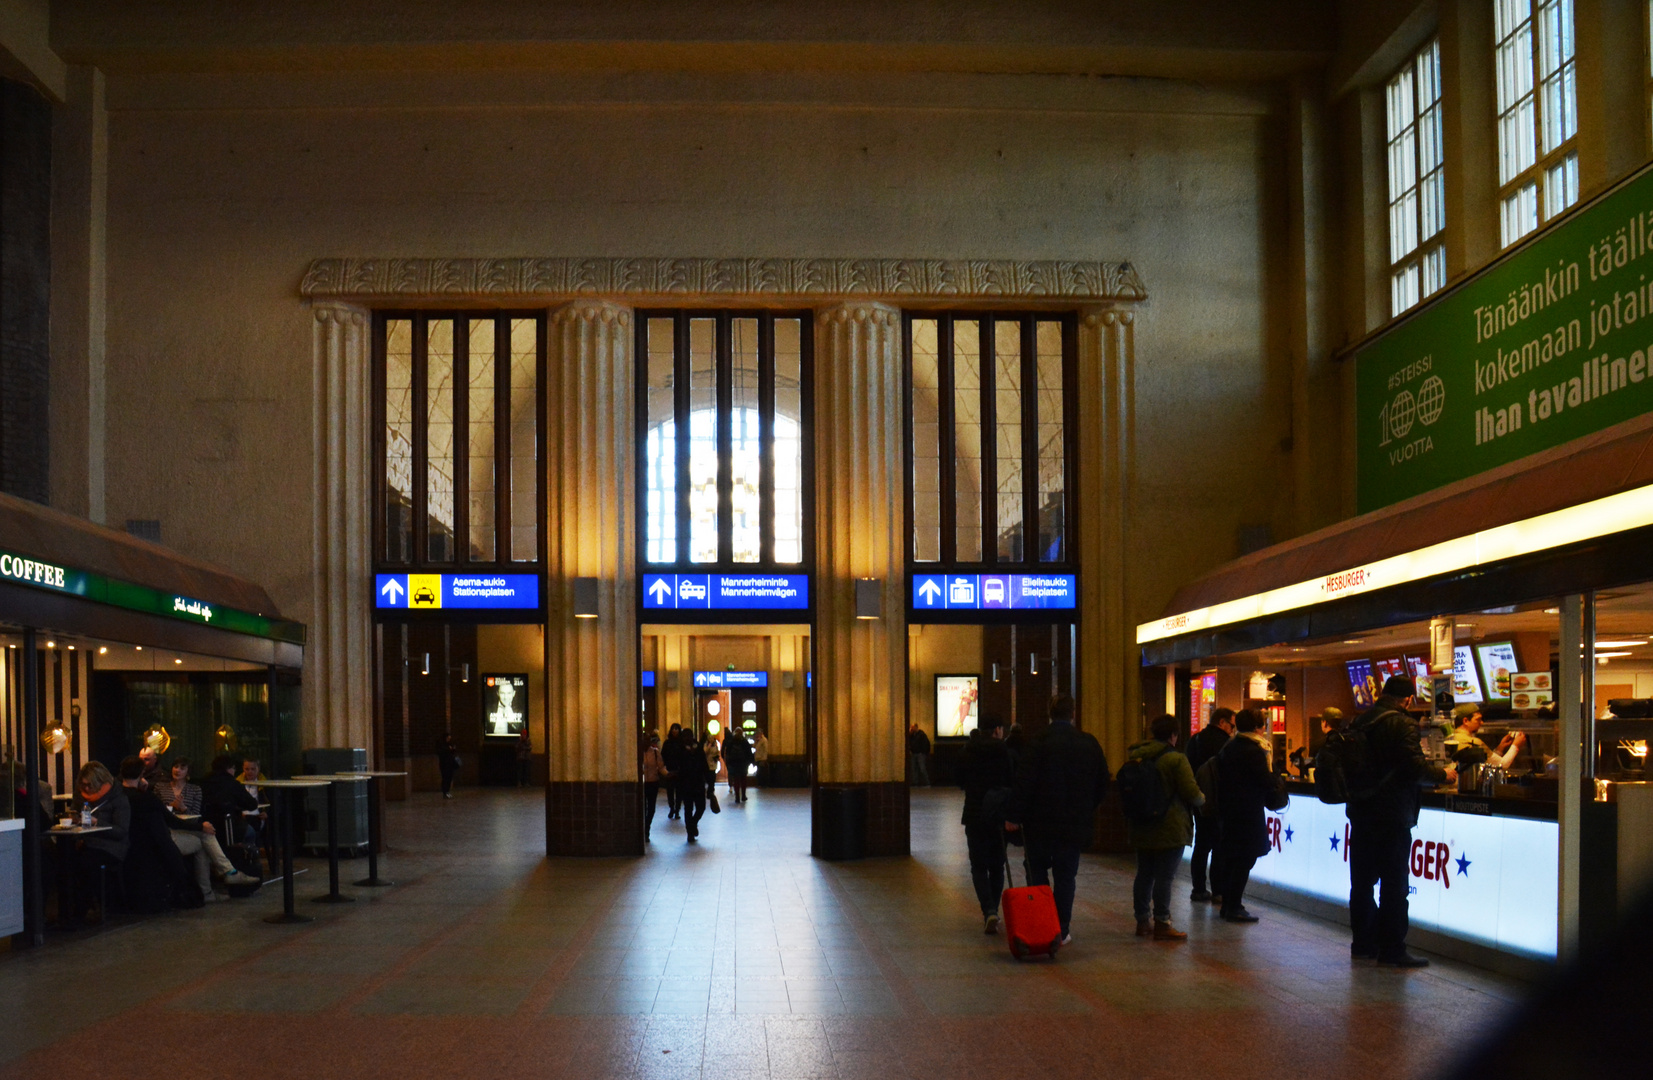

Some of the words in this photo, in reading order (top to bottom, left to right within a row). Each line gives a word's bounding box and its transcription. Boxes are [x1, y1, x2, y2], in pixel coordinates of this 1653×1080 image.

[1474, 259, 1580, 343] Tänäänkin
[1474, 318, 1581, 396] kokemaan
[1388, 353, 1432, 391] #STEISSI
[1475, 402, 1522, 446] Ihan
[1389, 435, 1434, 467] VUOTTA
[0, 554, 65, 588] COFFEE
[453, 577, 506, 587] Asema-aukio
[721, 577, 789, 587] Mannerheimintie
[1022, 577, 1068, 587] Elielinaukio
[1326, 569, 1365, 593] HESBURGER
[453, 587, 515, 598] Stationsplatsen
[721, 587, 797, 598] Mannerheimvägen
[1022, 587, 1068, 598] Elielplatsen
